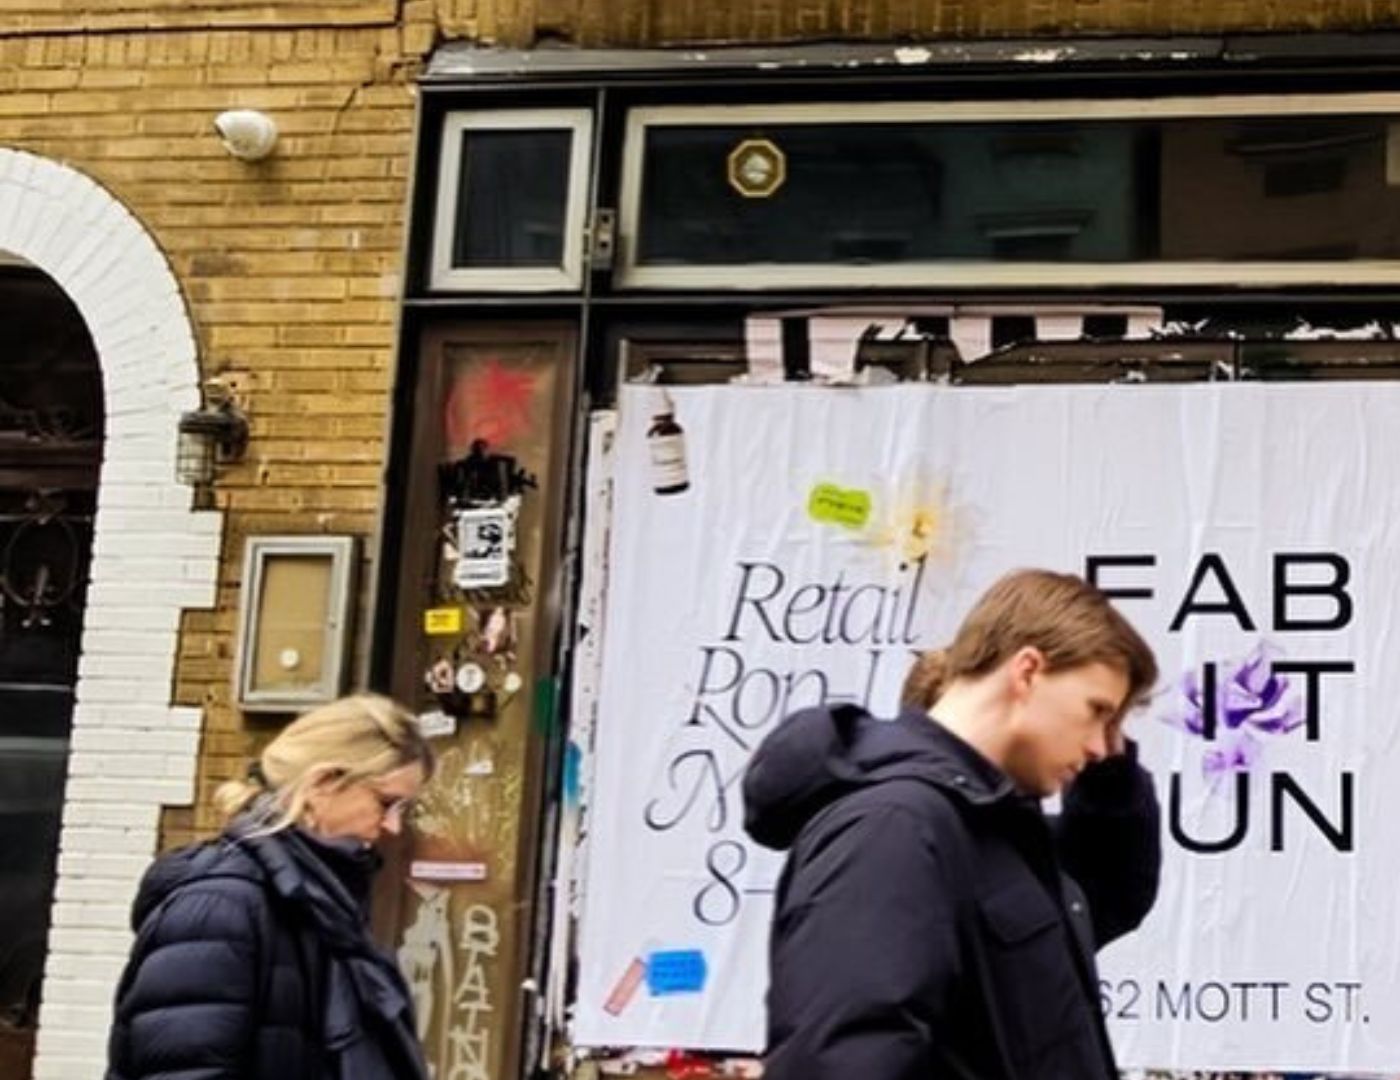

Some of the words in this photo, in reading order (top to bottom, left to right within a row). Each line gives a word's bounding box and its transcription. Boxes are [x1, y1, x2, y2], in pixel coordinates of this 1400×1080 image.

[723, 552, 930, 645] Retail
[1085, 552, 1355, 632] FAB
[1203, 661, 1355, 742] IT
[1169, 772, 1355, 853] UN
[1156, 980, 1290, 1023] MOTT
[1304, 981, 1370, 1023] ST.
